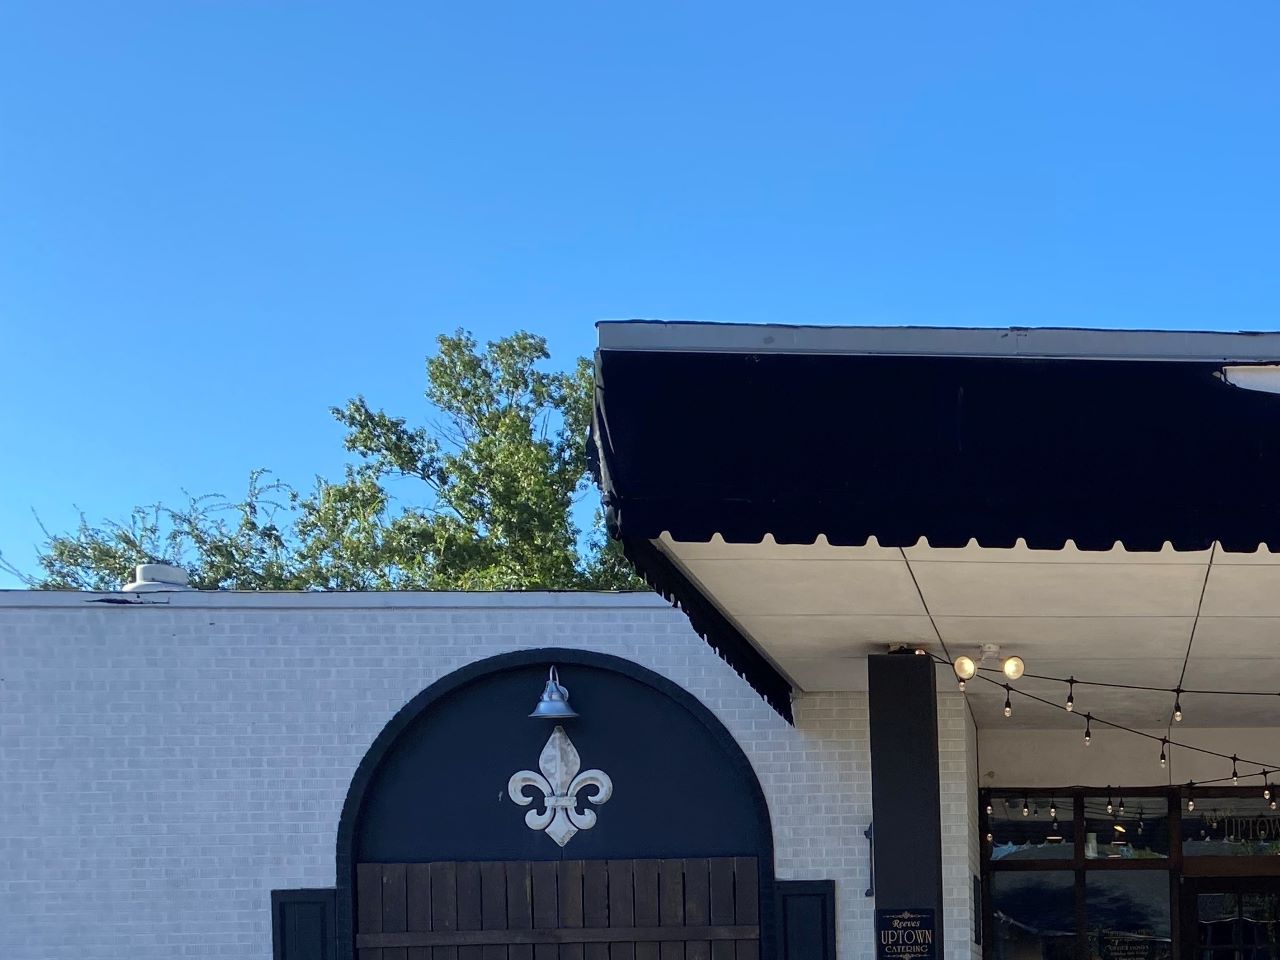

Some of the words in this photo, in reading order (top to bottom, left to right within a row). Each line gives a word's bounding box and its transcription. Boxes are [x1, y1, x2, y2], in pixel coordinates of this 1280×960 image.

[892, 919, 920, 928] Reeves
[881, 929, 932, 944] UPTOWN
[885, 945, 928, 953] CATERING
